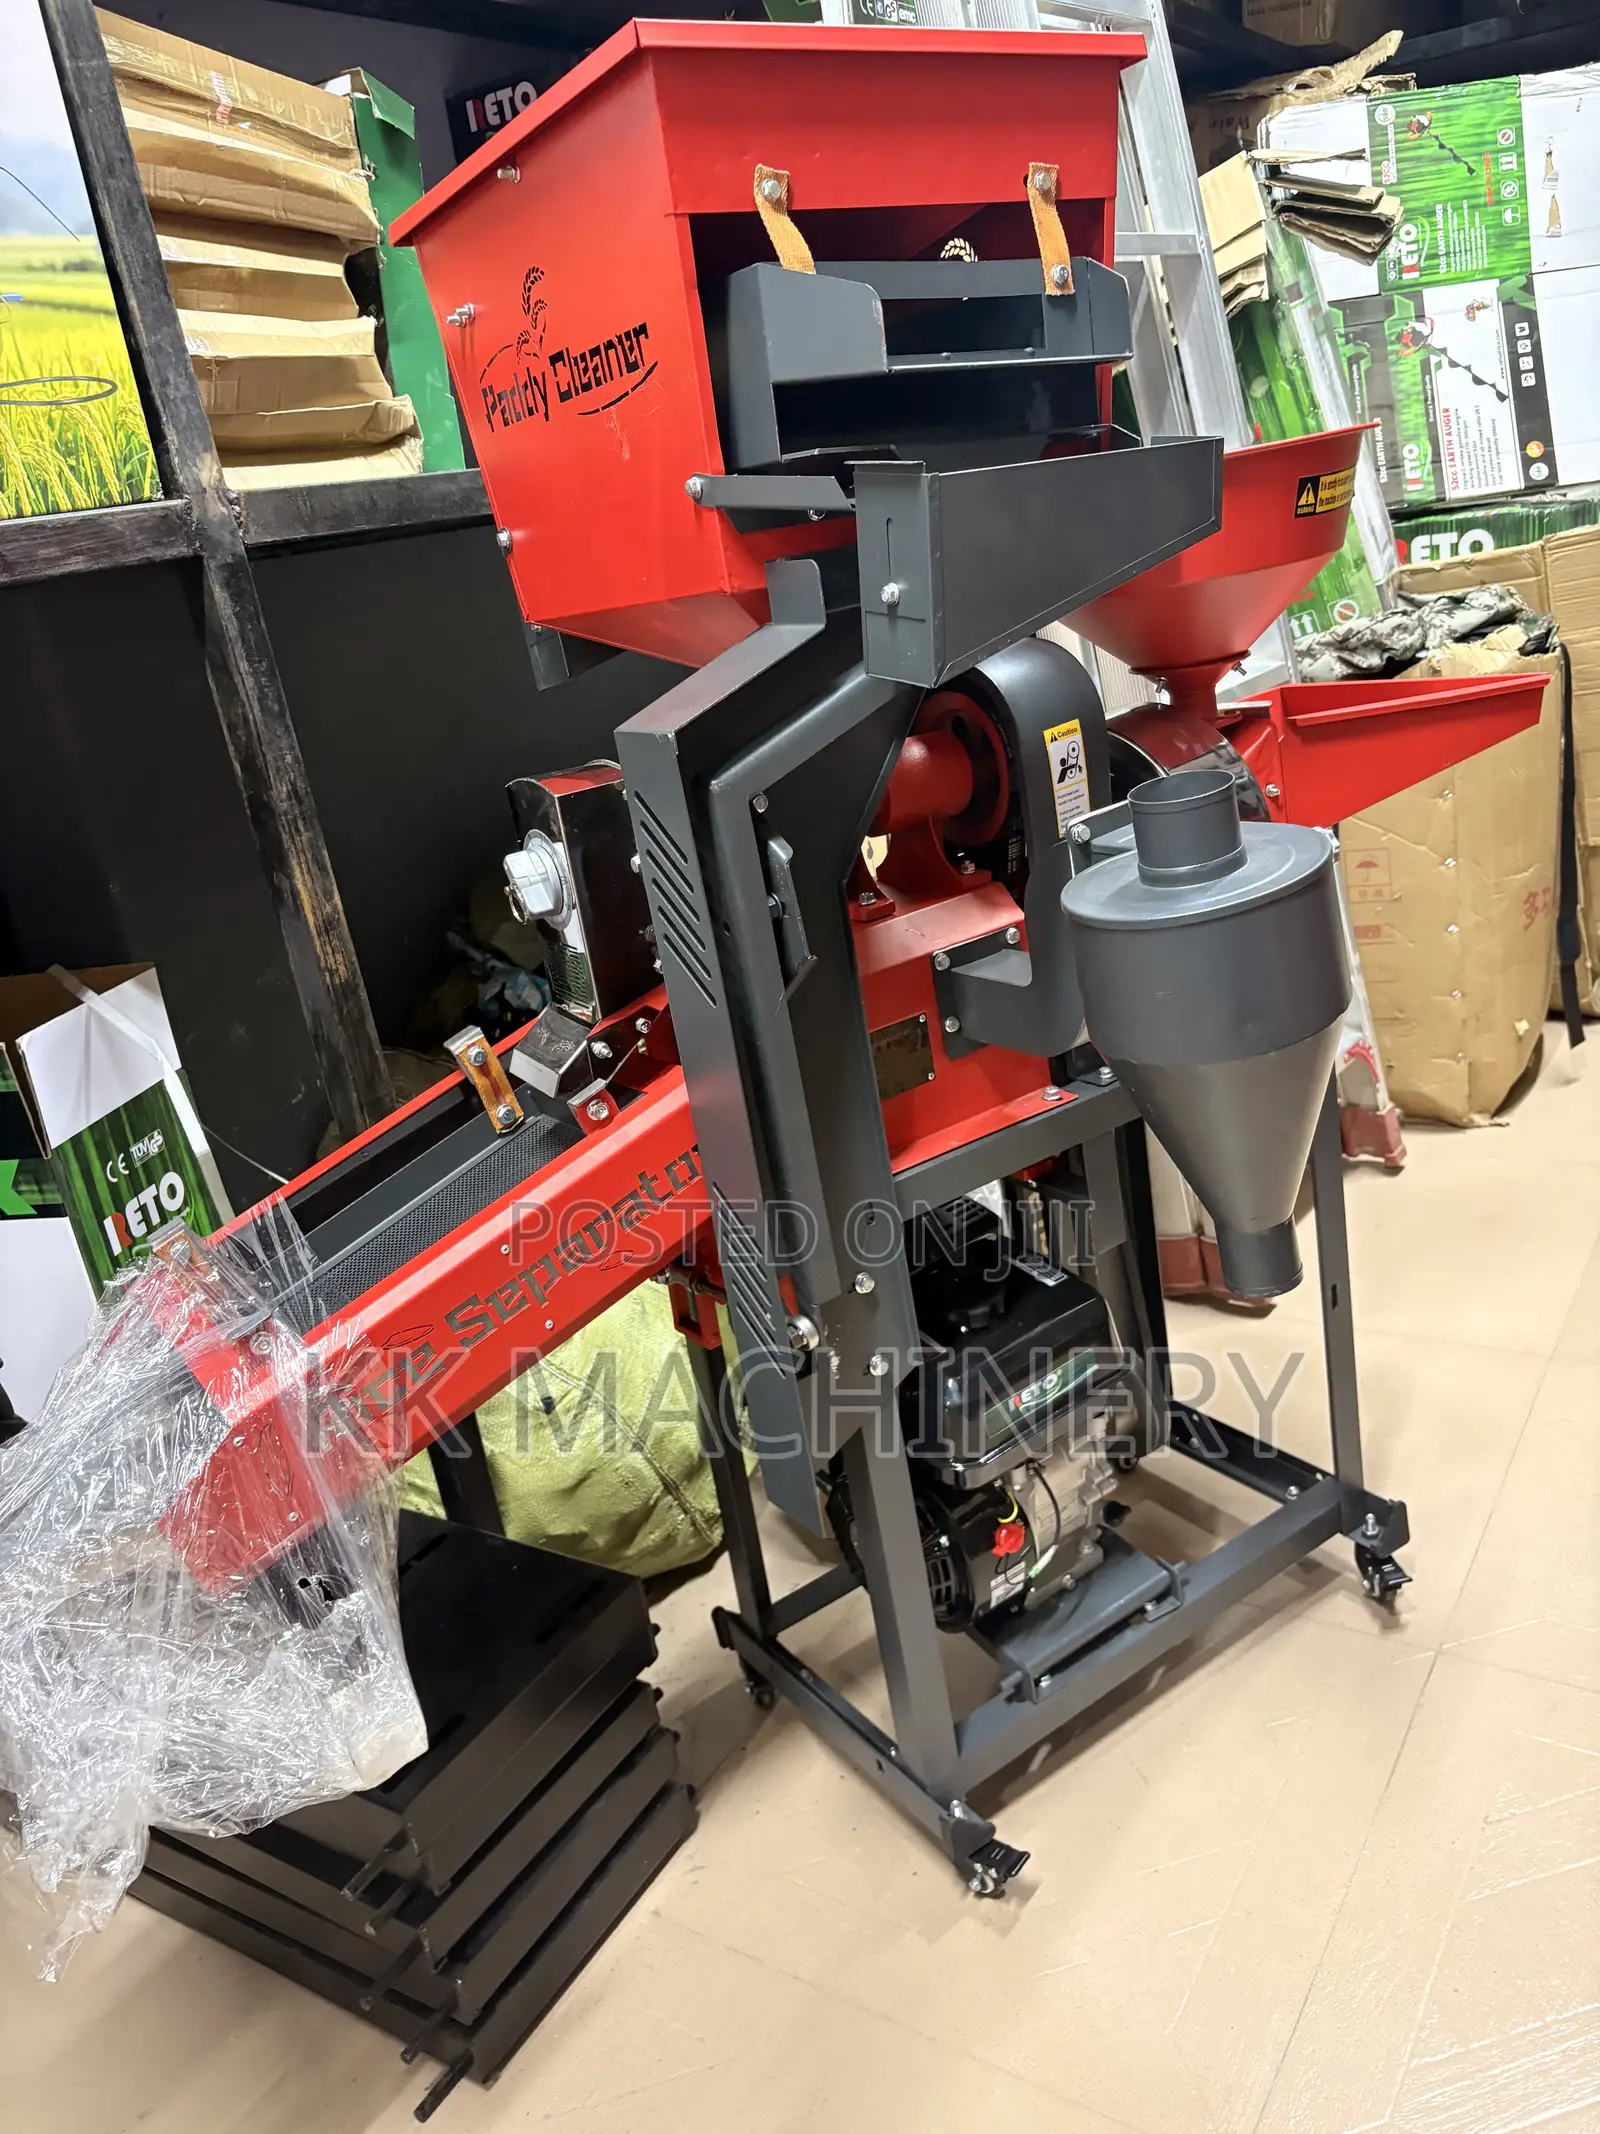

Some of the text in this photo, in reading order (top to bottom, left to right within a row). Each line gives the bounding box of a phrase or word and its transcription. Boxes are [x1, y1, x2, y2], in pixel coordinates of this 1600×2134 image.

[465, 80, 538, 133] RETO
[1399, 223, 1420, 280] RETO
[481, 321, 650, 433] Paddy Cleaner
[1372, 416, 1383, 441] AUGR
[1375, 441, 1386, 465] EARTH
[1442, 407, 1460, 491] 52cc EARTH AUGER
[1402, 443, 1424, 491] RETO
[1057, 727, 1078, 739] Caution
[106, 1152, 130, 1183] CE
[103, 1171, 185, 1257] RETO
[444, 1144, 702, 1350] Separato
[1007, 1373, 1059, 1412] RETO
